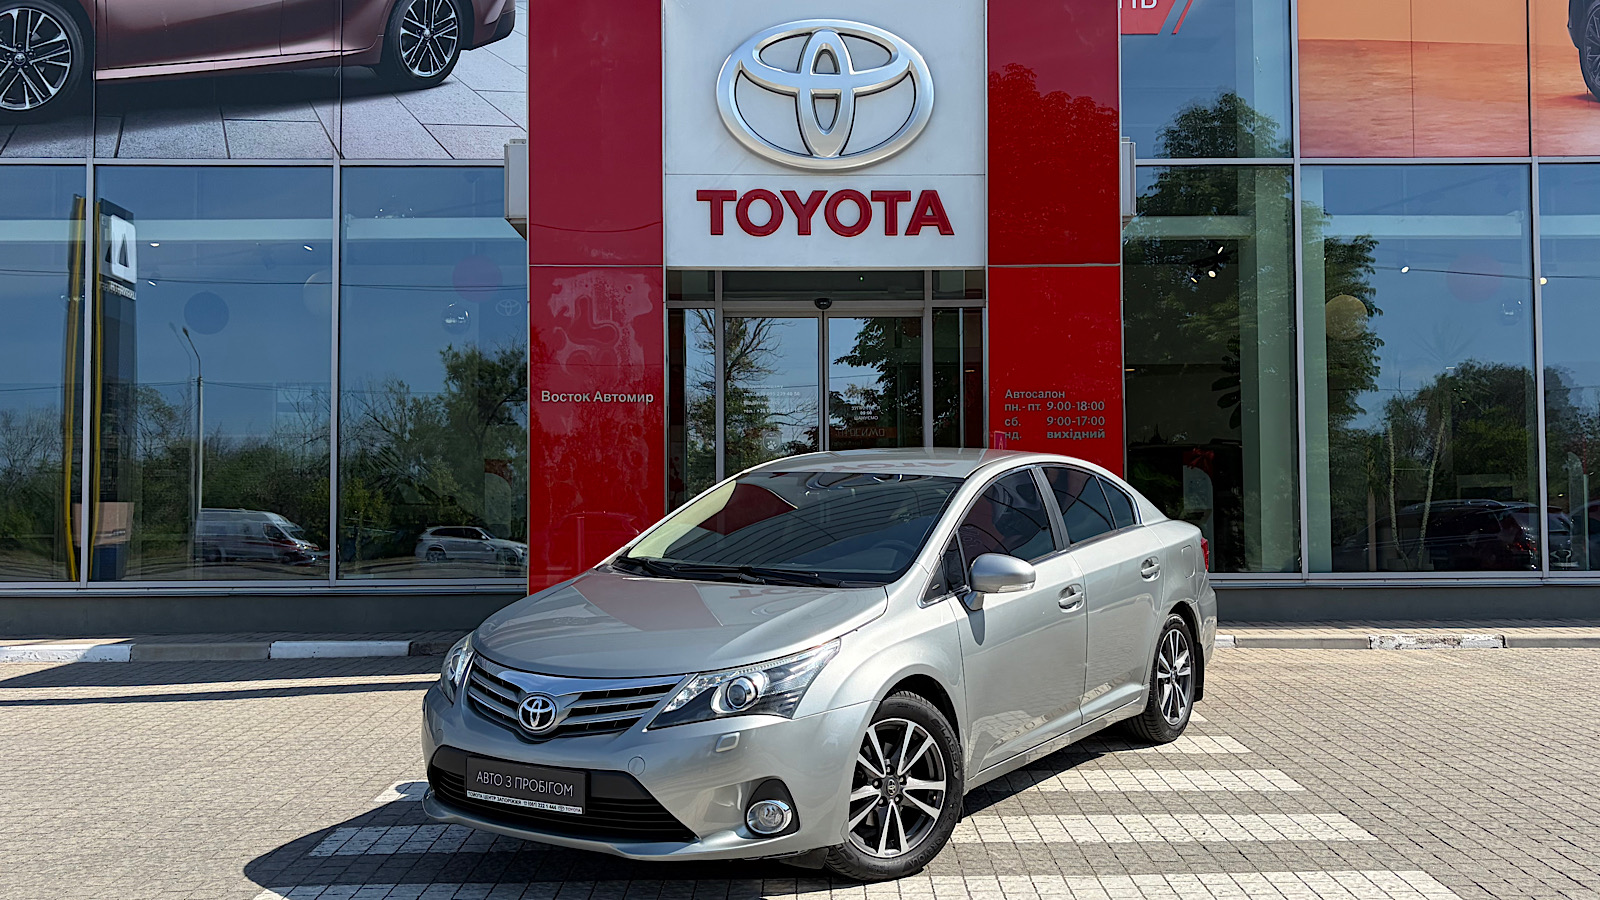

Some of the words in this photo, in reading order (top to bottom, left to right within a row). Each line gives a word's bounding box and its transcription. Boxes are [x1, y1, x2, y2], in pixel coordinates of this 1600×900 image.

[696, 188, 955, 237] TOYOTA
[541, 390, 591, 403] Восток
[593, 390, 654, 406] Автомир
[1004, 389, 1066, 399] Автосалон
[1046, 401, 1106, 411] 9:00-18:00
[1004, 417, 1022, 427] сб.
[1046, 416, 1106, 426] 9:00-17:00
[1004, 431, 1022, 441] нд.
[1046, 428, 1106, 441] вихідний
[476, 770, 503, 786] АВТО
[514, 776, 574, 797] ПРОБІГОМ
